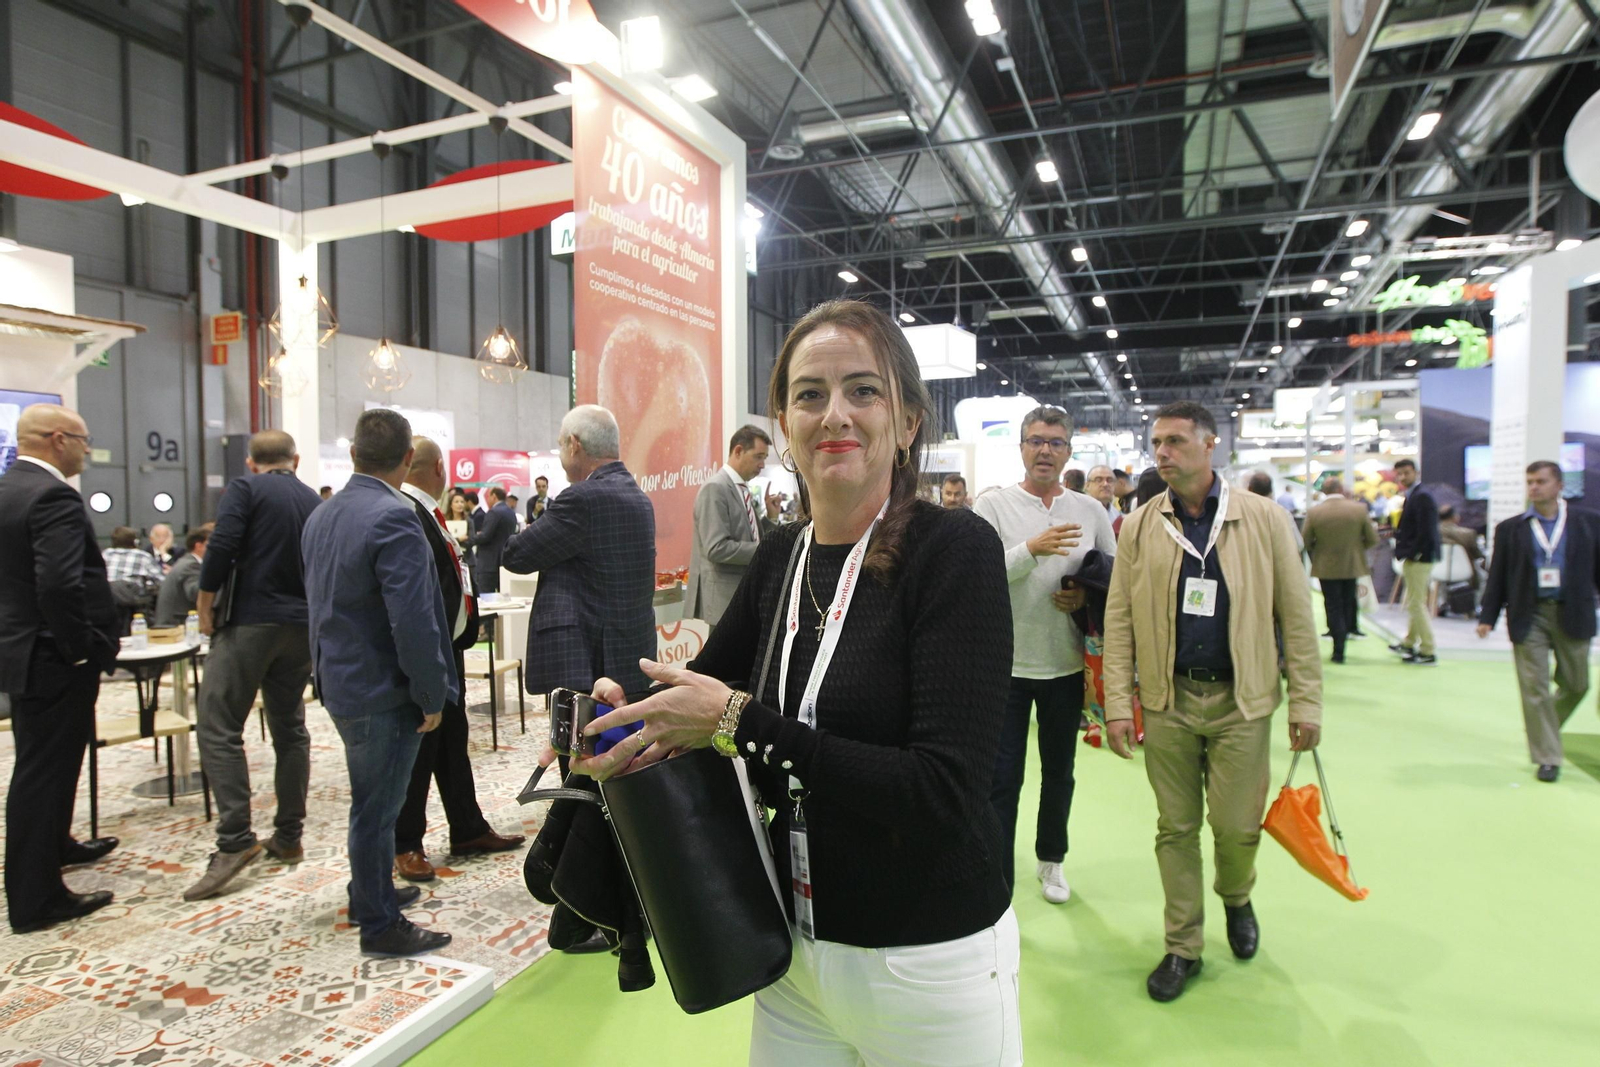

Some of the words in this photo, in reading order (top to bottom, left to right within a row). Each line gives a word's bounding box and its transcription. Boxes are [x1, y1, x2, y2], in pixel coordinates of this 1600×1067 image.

[600, 134, 645, 204] 40
[649, 181, 709, 240] años
[588, 194, 650, 241] trabajando
[651, 228, 677, 254] desde
[612, 235, 639, 260] para
[641, 246, 651, 263] el
[652, 253, 699, 284] agricultor
[589, 261, 634, 289] Cumplimos
[635, 281, 641, 292] 4
[641, 283, 671, 302] décadas
[671, 296, 683, 307] con
[684, 300, 693, 310] un
[693, 303, 715, 318] modelo
[589, 279, 636, 303] cooperativo
[637, 296, 669, 315] centrado
[669, 308, 678, 318] en
[678, 309, 689, 321] las
[689, 315, 716, 331] personas
[147, 431, 179, 462] 9a
[640, 473, 661, 492] por
[661, 470, 680, 490] ser
[837, 561, 858, 609] Santander
[852, 541, 864, 562] Agro
[658, 641, 693, 664] ASOL
